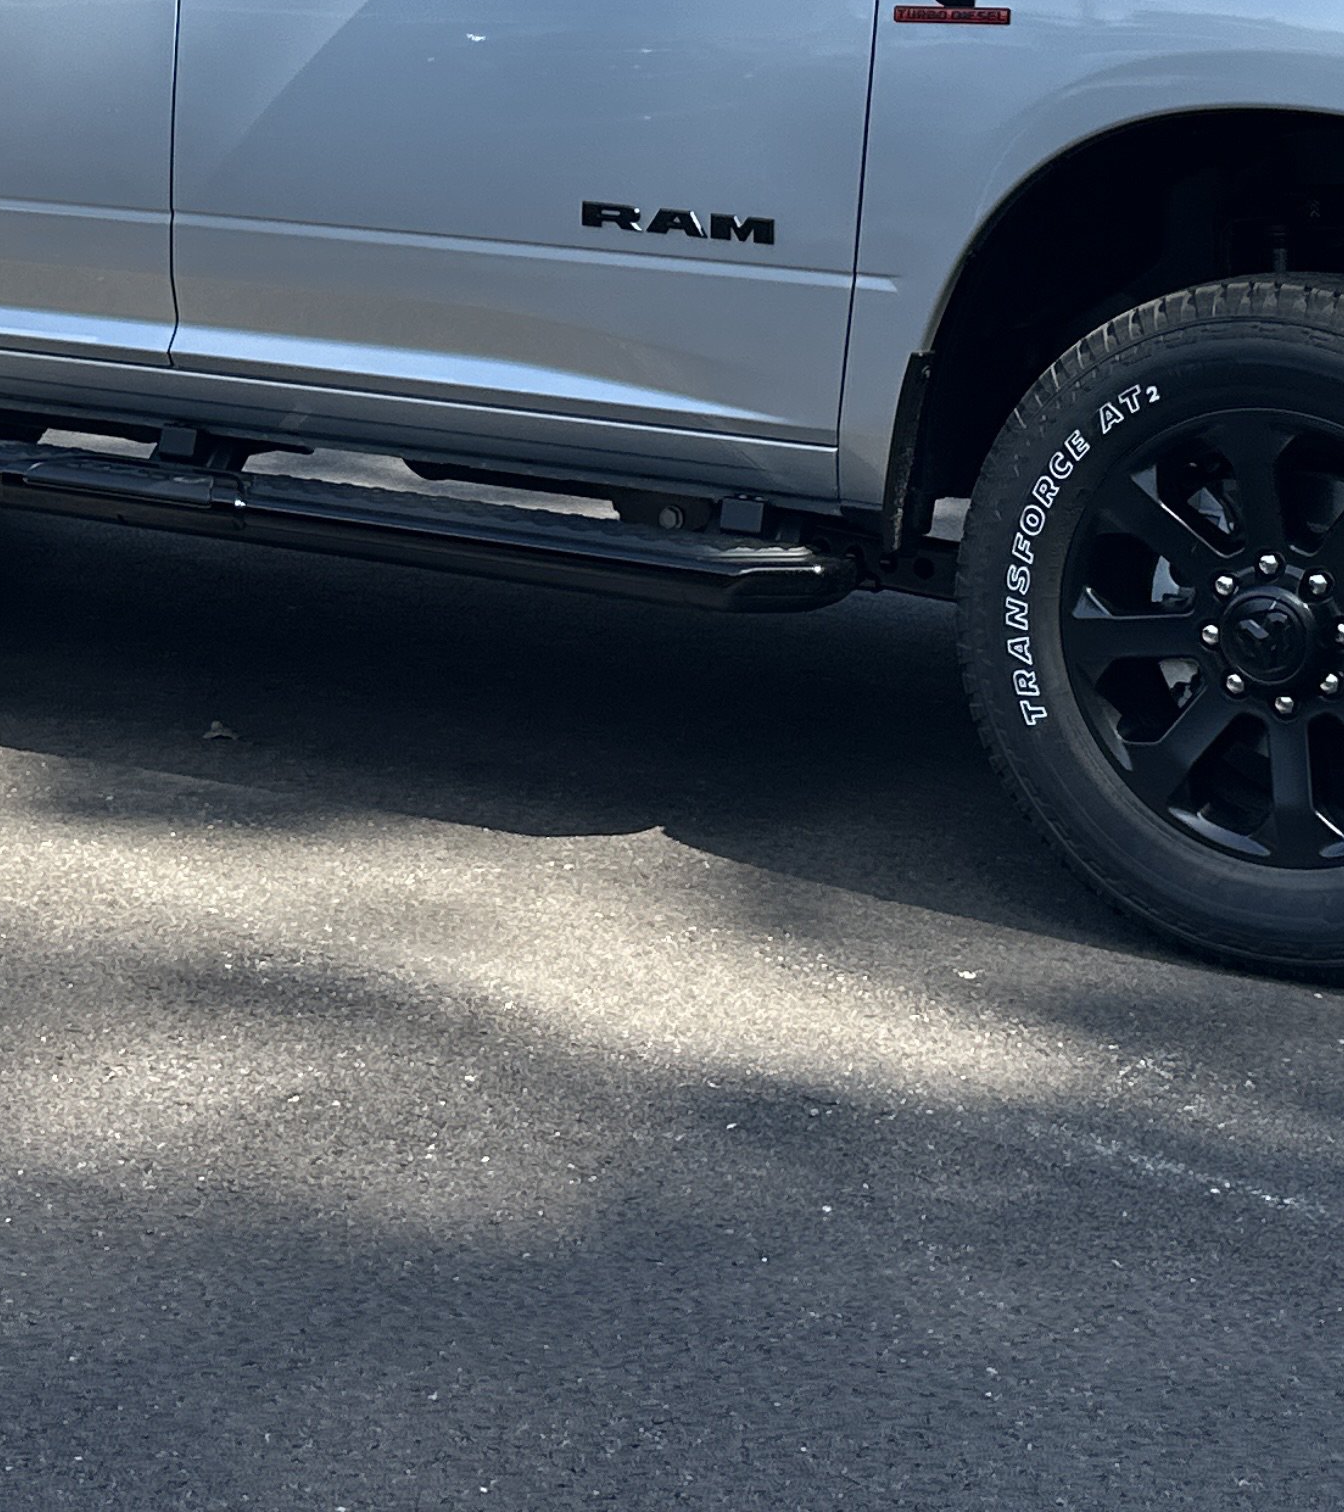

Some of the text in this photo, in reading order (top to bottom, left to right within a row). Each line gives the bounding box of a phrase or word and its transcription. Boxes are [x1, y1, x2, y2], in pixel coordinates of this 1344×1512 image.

[896, 8, 1007, 23] TURBO DIESEL
[581, 200, 775, 246] RAM
[1004, 429, 1091, 727] TRANSFORCE
